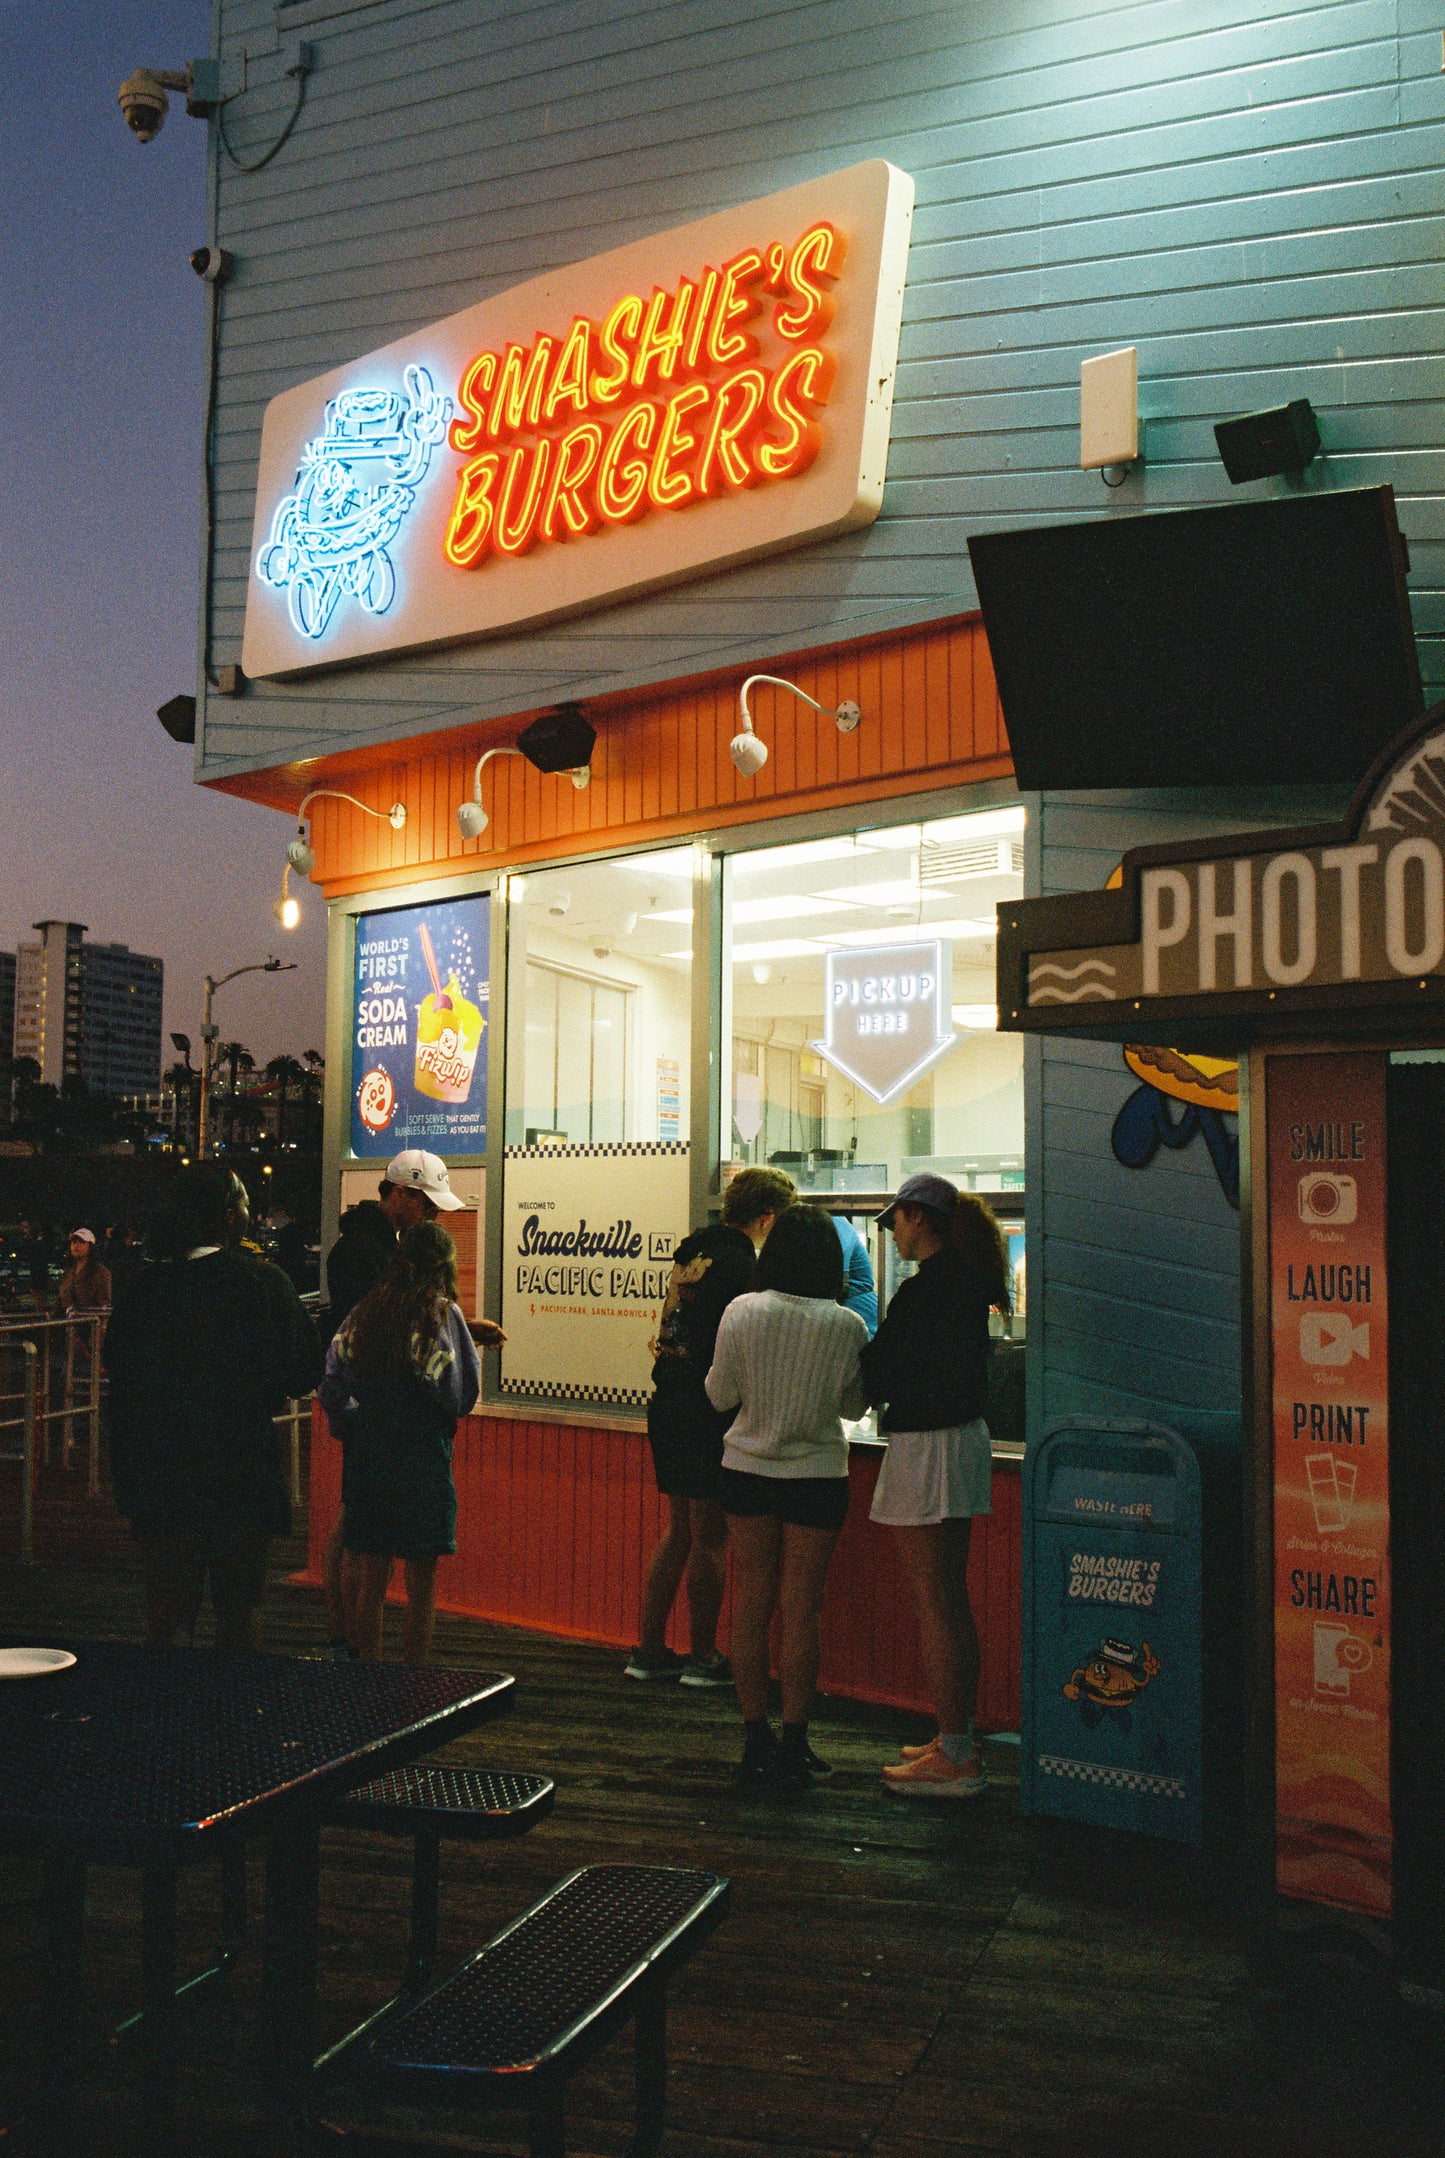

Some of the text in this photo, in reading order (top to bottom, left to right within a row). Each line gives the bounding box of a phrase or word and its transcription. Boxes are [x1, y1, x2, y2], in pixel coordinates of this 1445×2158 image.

[449, 221, 846, 454] SMASHIE'S
[442, 348, 838, 569] BURGERS
[1141, 837, 1444, 994] PHOTO
[359, 937, 409, 957] WORLD'S
[358, 954, 408, 980] FIRST
[373, 980, 394, 994] Real
[833, 975, 932, 1004] PICKUP
[358, 997, 408, 1025] SODA
[858, 1014, 906, 1032] HERE
[357, 1024, 407, 1048] CREAM
[394, 1126, 421, 1137] BUBBLES
[421, 1126, 427, 1135] &
[427, 1125, 448, 1135] FIZZES
[449, 1126, 457, 1134] AS
[457, 1126, 469, 1134] YOU
[469, 1125, 480, 1134] EAT
[408, 1114, 424, 1125] SOFT
[425, 1113, 445, 1124] SERVE
[459, 1114, 481, 1123] GENTLY
[1288, 1121, 1365, 1162] SMILE
[518, 1201, 555, 1210] WELCOME TO
[517, 1214, 671, 1259] Snackville AT
[1309, 1229, 1345, 1243] Photos
[517, 1265, 604, 1298] PACIFIC
[1287, 1264, 1372, 1304] LAUGH
[540, 1304, 567, 1314] PACIFIC
[591, 1307, 615, 1316] SANTA
[617, 1309, 648, 1318] MONICA
[1313, 1373, 1345, 1386] Video
[1292, 1402, 1370, 1446] PRINT
[1286, 1535, 1319, 1553] Strips
[1332, 1541, 1377, 1560] Collages
[1069, 1552, 1161, 1583] SMASHIE'S
[1068, 1574, 1157, 1606] BURGERS
[1290, 1569, 1376, 1618] SHARE
